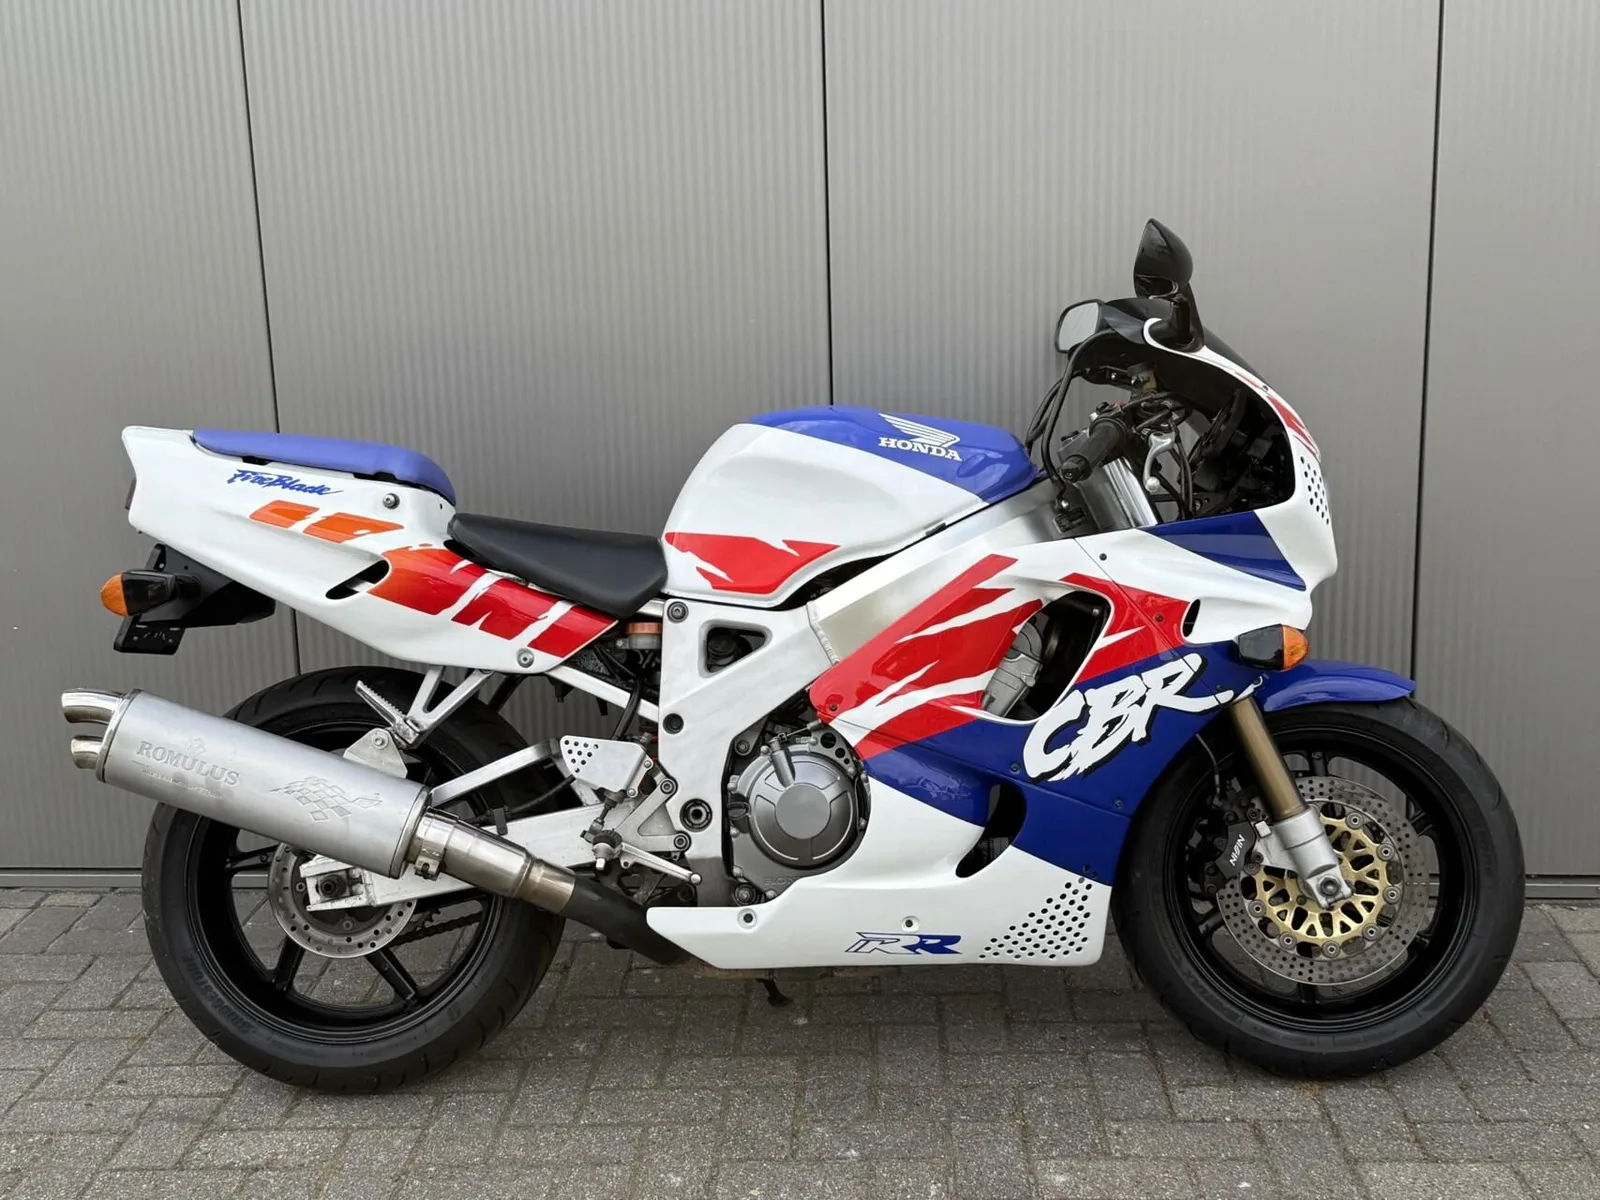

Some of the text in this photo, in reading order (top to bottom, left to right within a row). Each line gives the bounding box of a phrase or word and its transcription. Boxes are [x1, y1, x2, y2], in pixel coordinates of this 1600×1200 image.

[878, 437, 962, 461] HONDA
[1023, 653, 1234, 782] CBR
[136, 741, 241, 786] ROMULUS
[845, 932, 962, 954] RR
